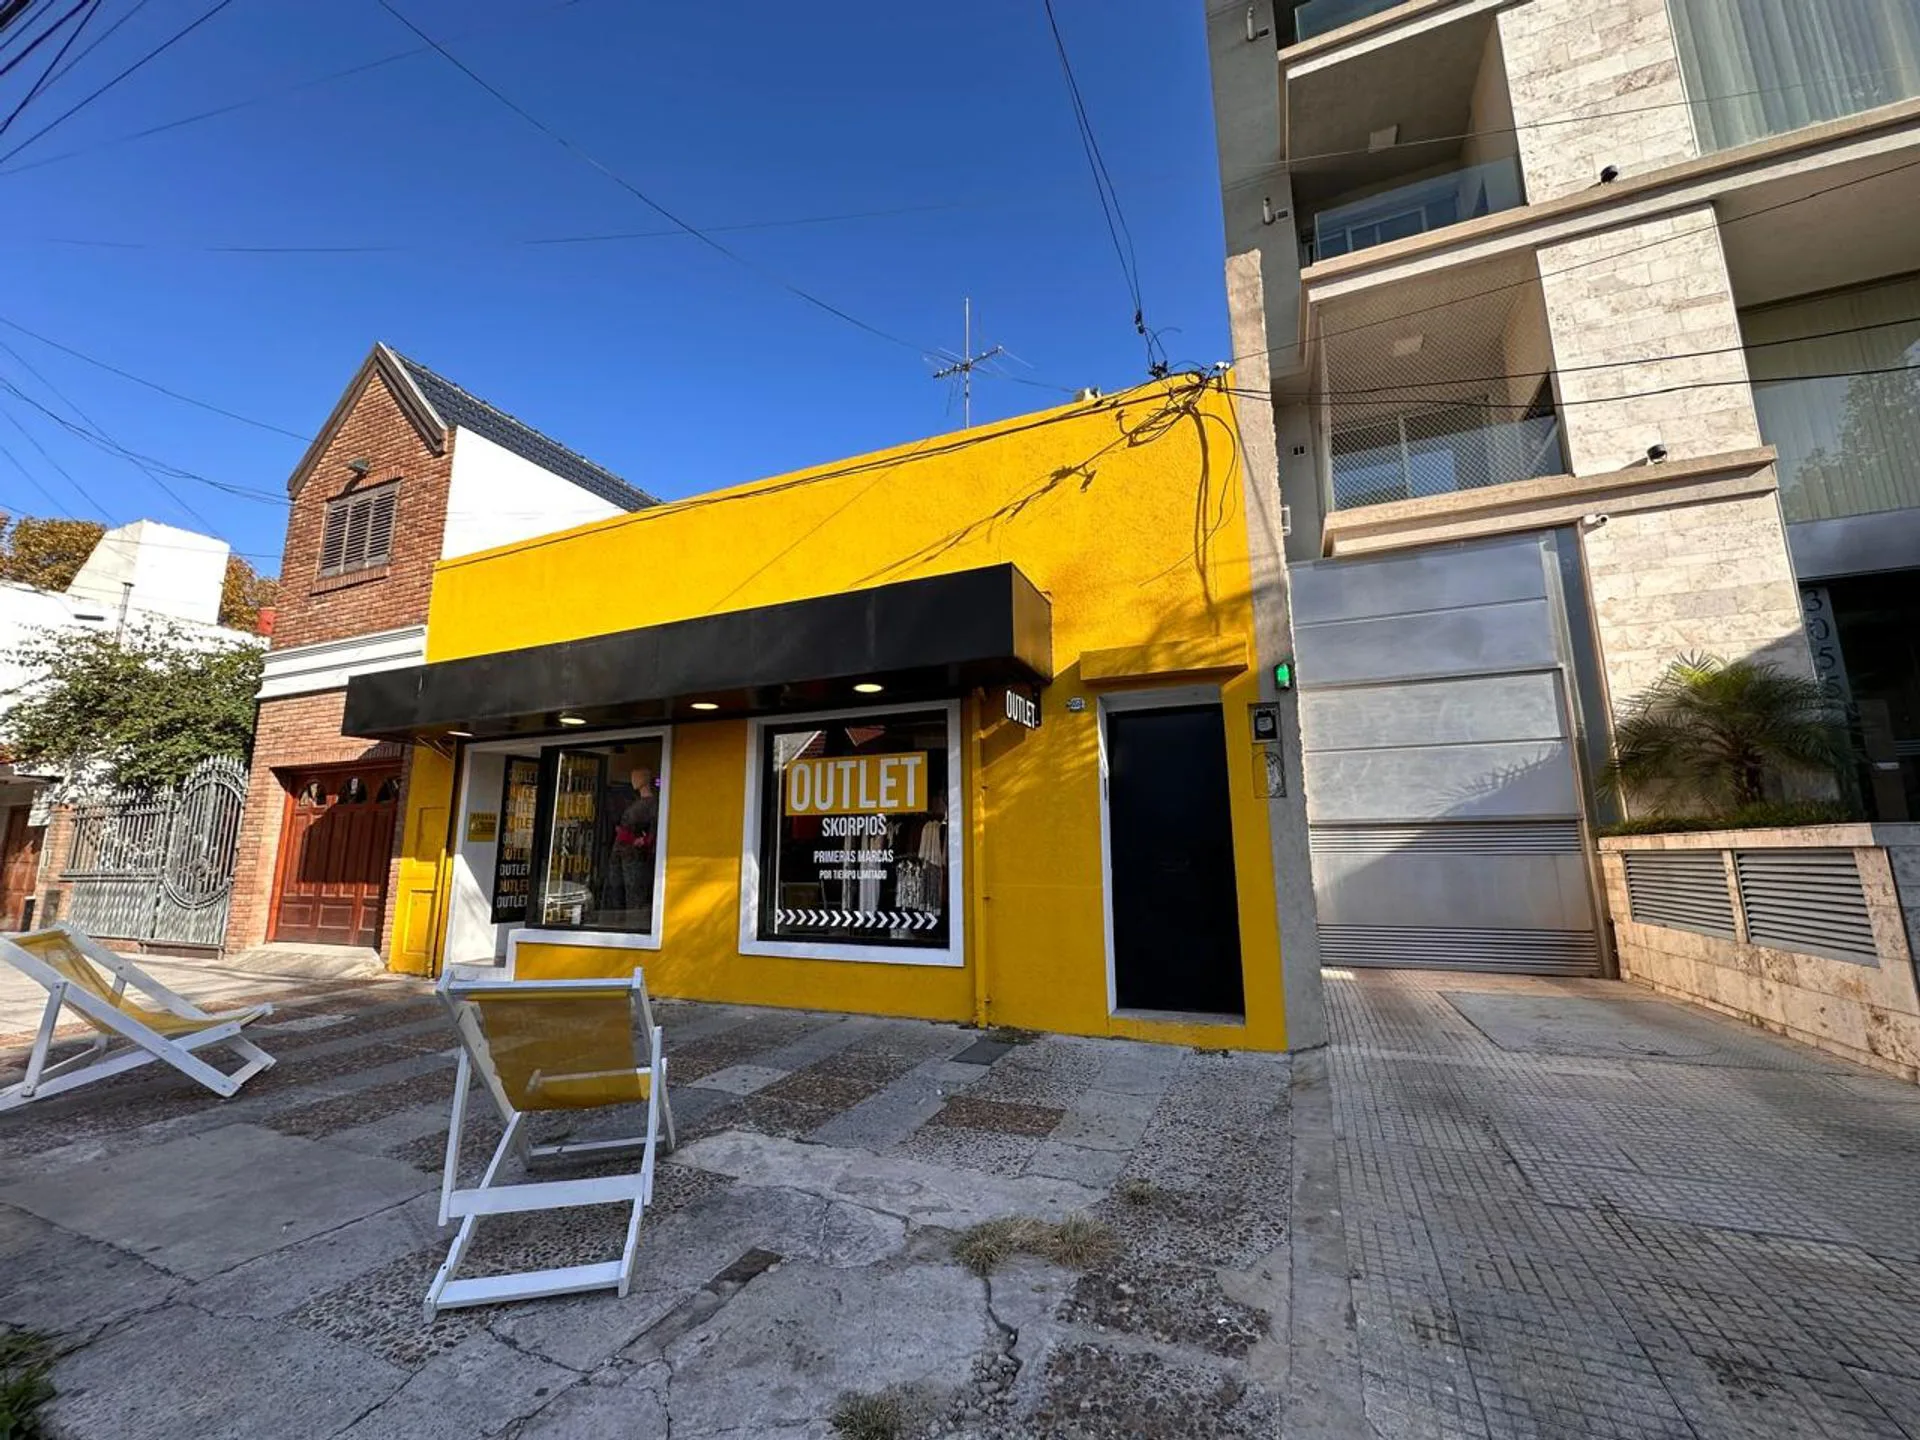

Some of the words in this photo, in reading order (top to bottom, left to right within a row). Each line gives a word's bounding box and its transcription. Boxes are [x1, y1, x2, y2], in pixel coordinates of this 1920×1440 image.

[1006, 690, 1036, 728] OUTLET
[790, 756, 922, 812] OUTLET
[822, 815, 887, 837] SKORPIOS
[813, 850, 856, 863] PRIMERAS
[857, 849, 894, 863] MARCAS
